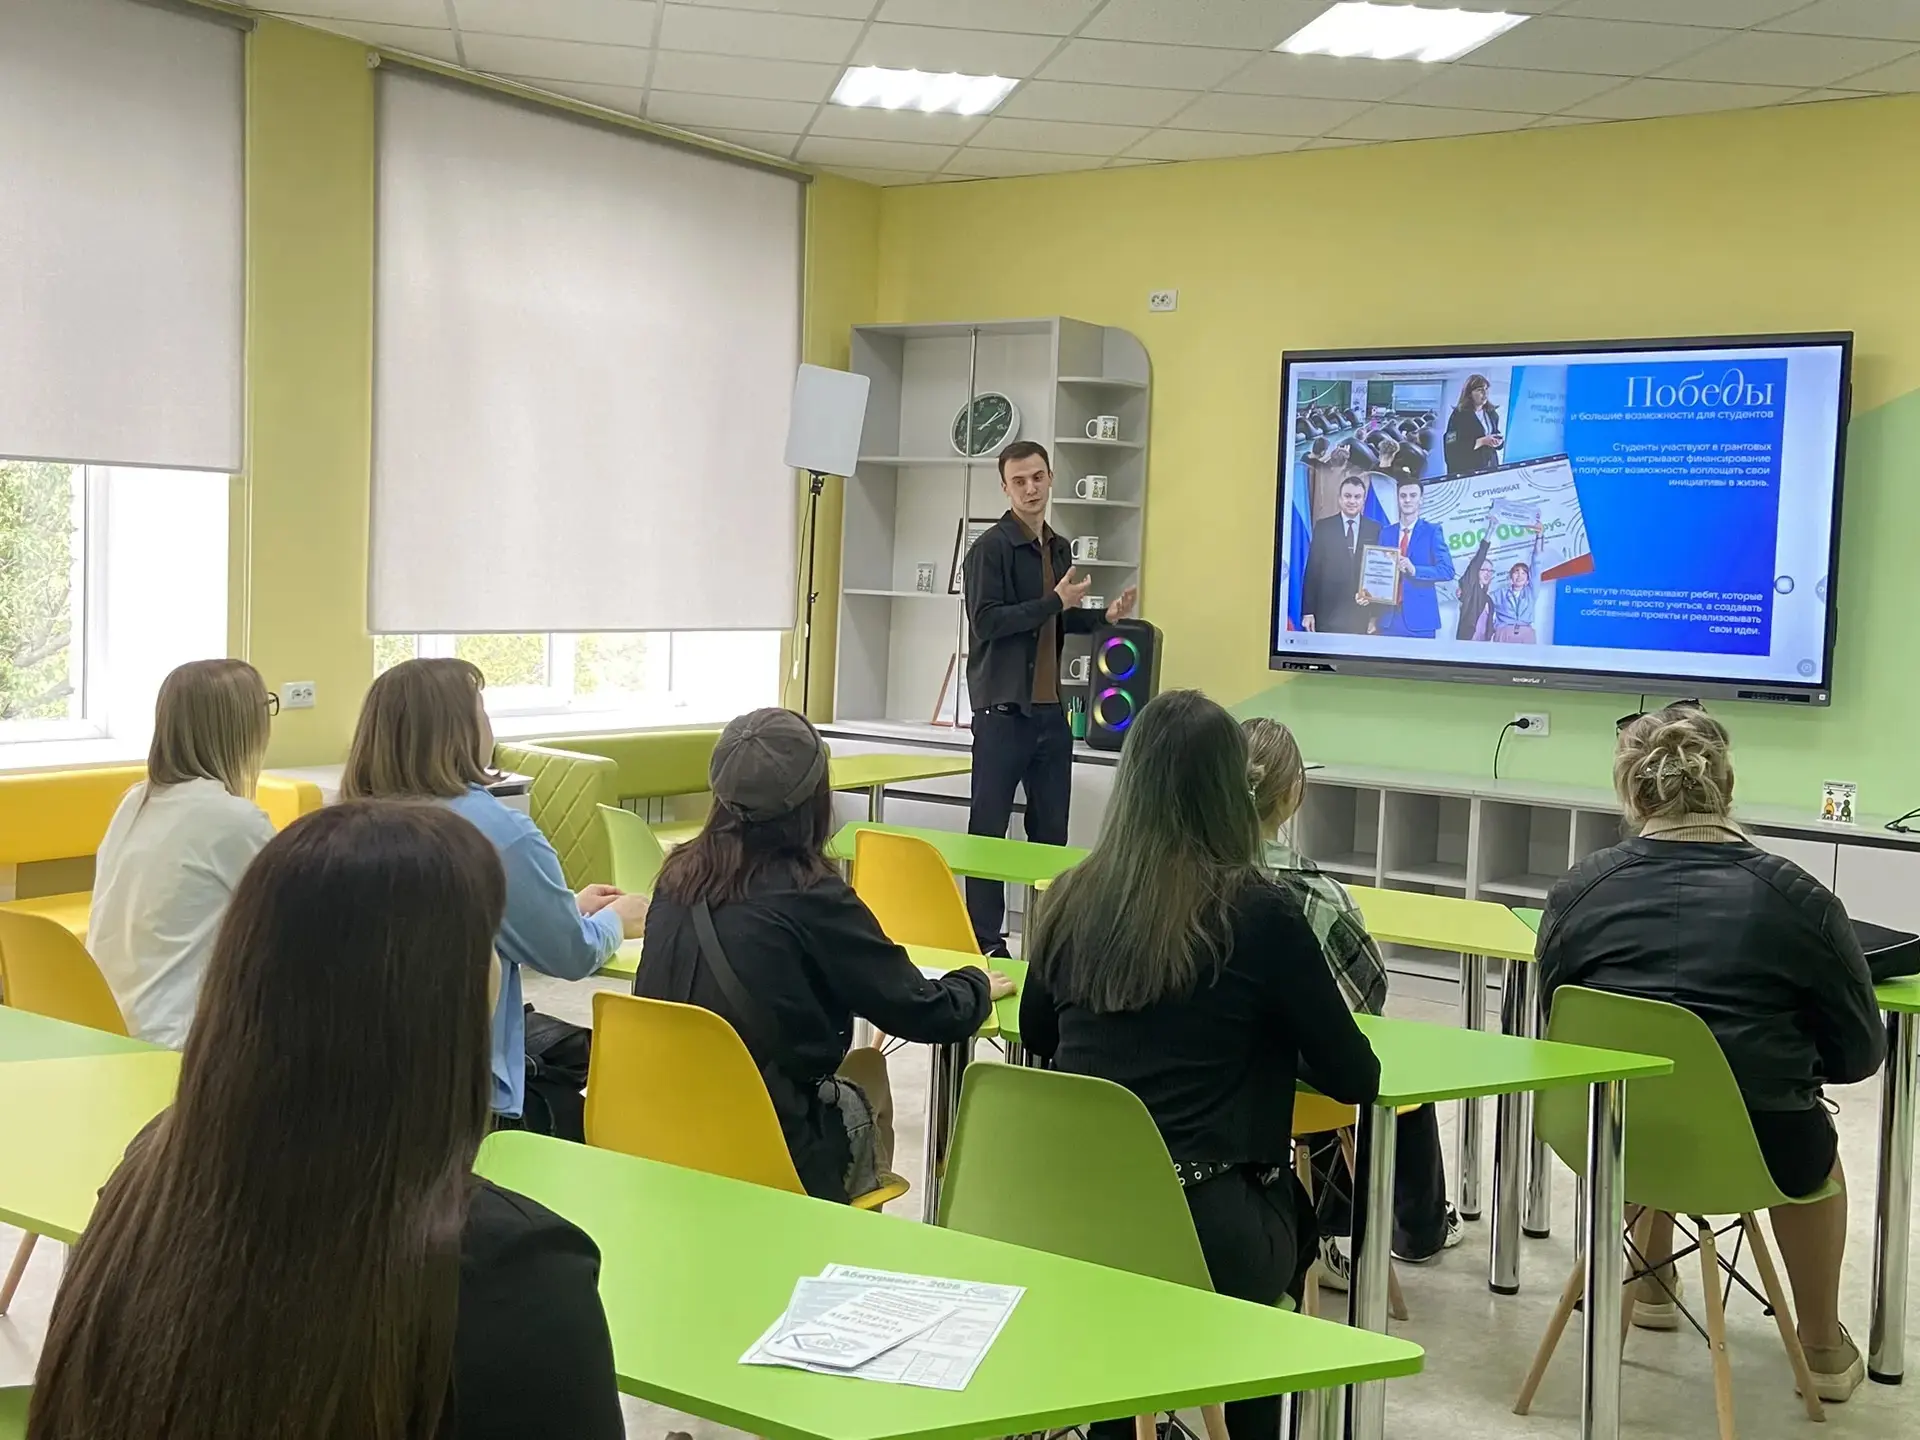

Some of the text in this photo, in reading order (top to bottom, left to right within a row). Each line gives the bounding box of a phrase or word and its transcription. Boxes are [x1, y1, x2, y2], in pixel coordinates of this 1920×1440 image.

[1625, 368, 1775, 407] Победы
[1571, 411, 1774, 421] и большие возможности для студентов
[1612, 442, 1772, 453] Студенты участвуют в грантовых
[1575, 453, 1772, 464] конкурсах, выигрывают финансирование
[1579, 467, 1622, 476] получают
[1624, 467, 1688, 475] возможность
[1690, 467, 1744, 475] воплощать
[1745, 467, 1770, 475] свои
[1668, 479, 1770, 488] инициативы в жизнь.
[1472, 483, 1521, 499] СЕРТИФИКАТ
[1565, 585, 1763, 602] В институте поддерживают ребят, которые
[1632, 600, 1665, 609] просто
[1666, 602, 1704, 611] учиться,
[1714, 603, 1762, 613] создавать
[1581, 608, 1640, 618] собственные
[1641, 611, 1680, 620] проекты
[1690, 613, 1762, 624] реализовывать
[1734, 627, 1761, 636] идеи.
